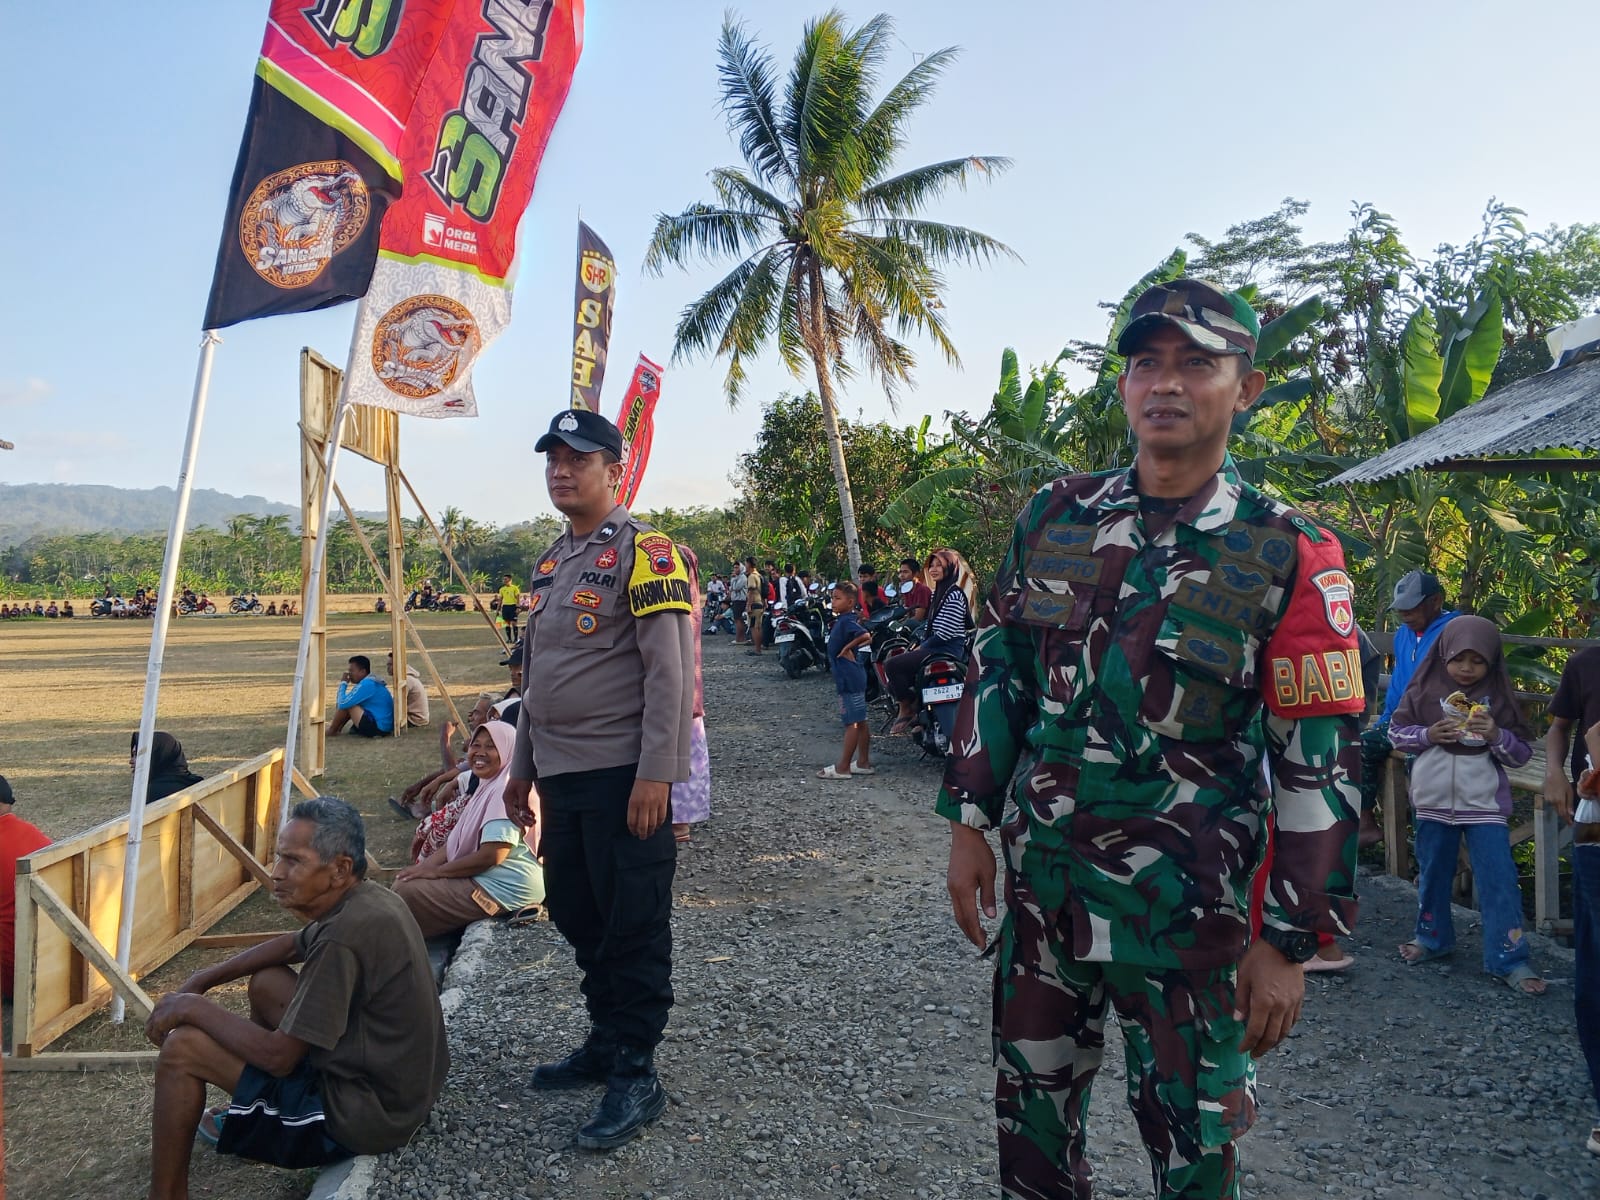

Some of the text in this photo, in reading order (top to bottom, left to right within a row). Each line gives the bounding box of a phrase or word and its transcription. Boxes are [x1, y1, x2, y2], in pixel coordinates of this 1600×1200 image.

[585, 264, 606, 285] SHR
[579, 571, 616, 589] POLRI
[1188, 585, 1230, 616] TNI
